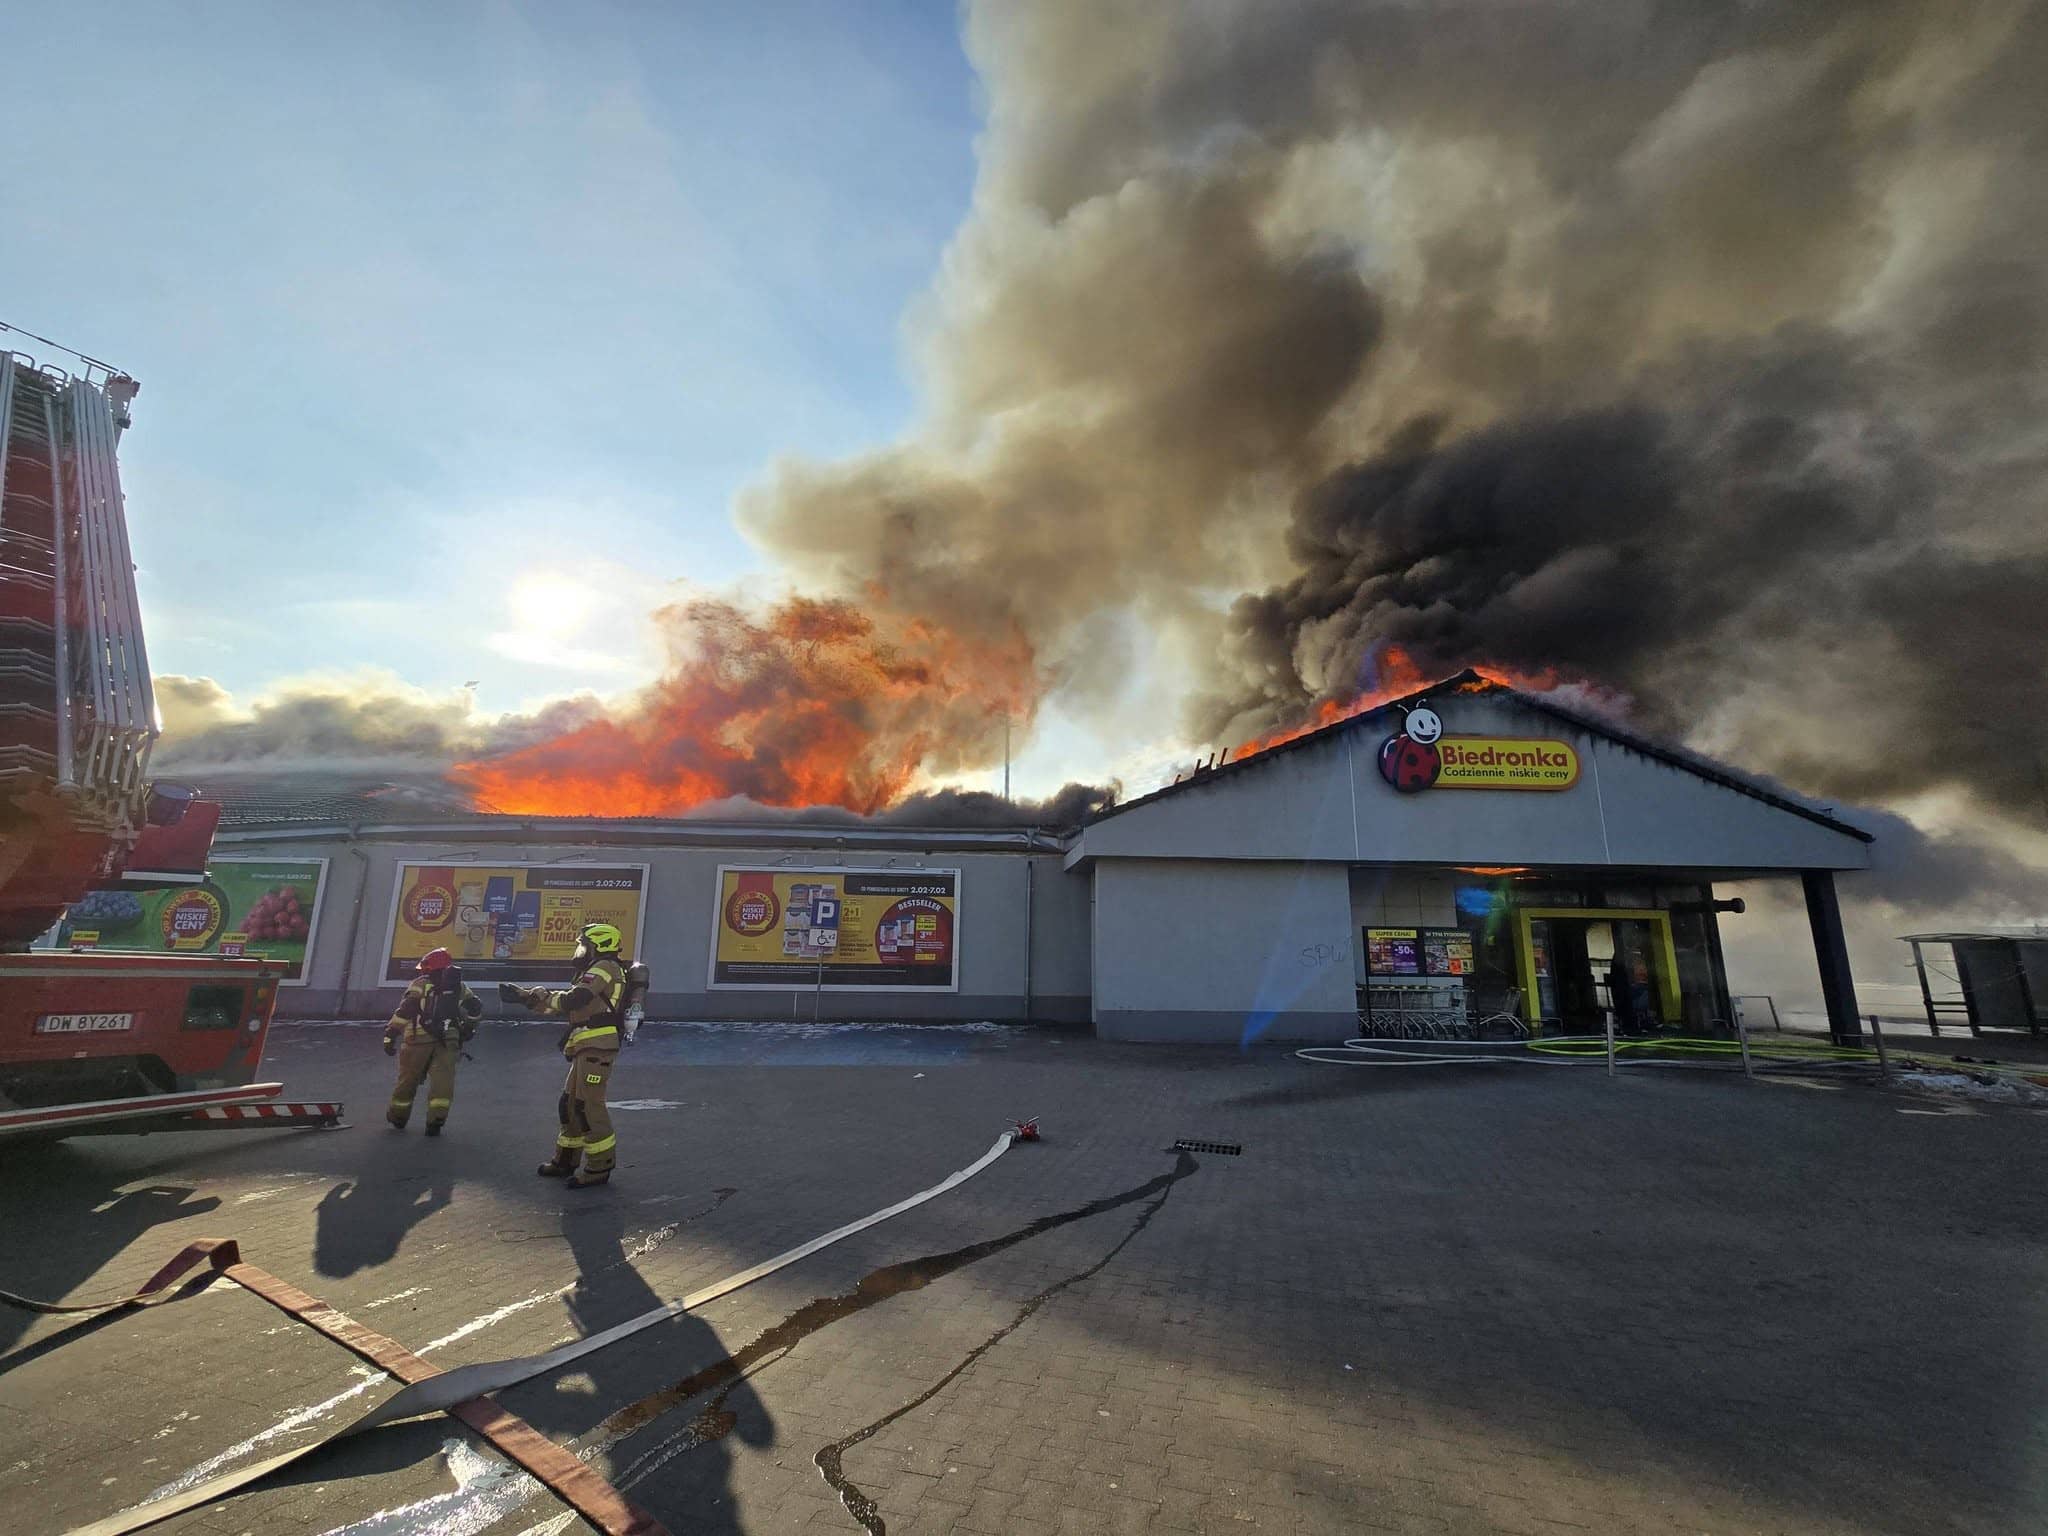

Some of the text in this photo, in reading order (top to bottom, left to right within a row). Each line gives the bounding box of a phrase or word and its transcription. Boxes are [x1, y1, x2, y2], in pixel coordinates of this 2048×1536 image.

[1441, 745, 1568, 767] Biedronka
[1444, 767, 1569, 780] Codziennie niskie ceny
[595, 879, 633, 887] 2.02-7.02
[910, 886, 946, 894] 2.02-7.02
[419, 907, 442, 915] CENY
[897, 899, 942, 912] BESTSELLER
[175, 912, 209, 921] NISKIE
[816, 901, 835, 925] P
[174, 920, 206, 930] CENY
[544, 917, 577, 931] 50%
[49, 1015, 126, 1030] DW 8Y261
